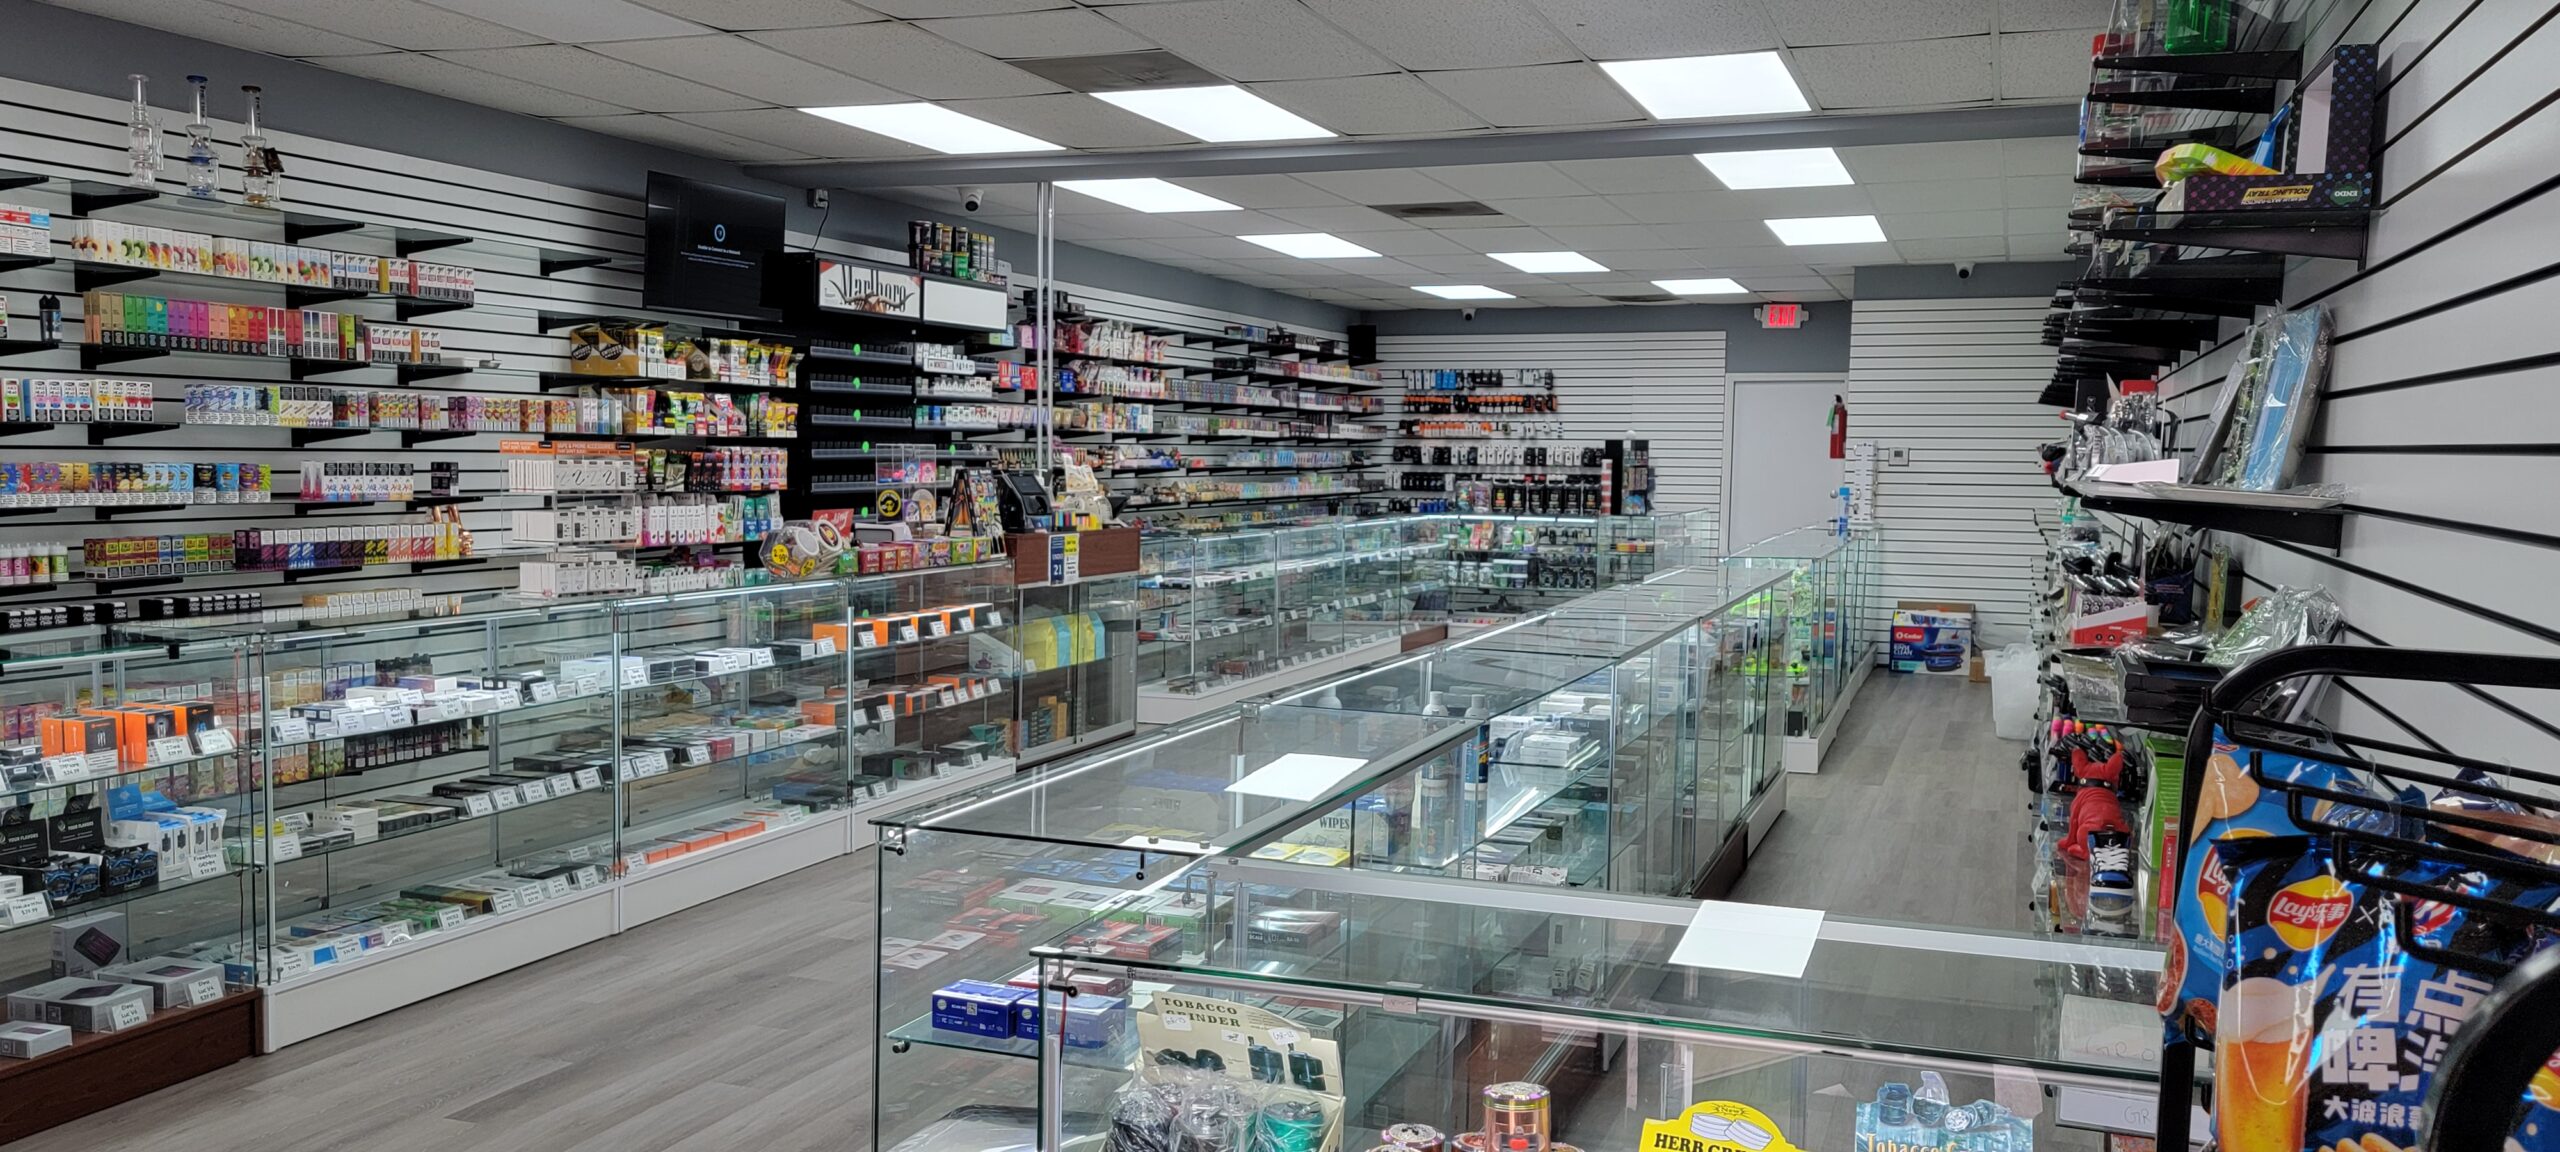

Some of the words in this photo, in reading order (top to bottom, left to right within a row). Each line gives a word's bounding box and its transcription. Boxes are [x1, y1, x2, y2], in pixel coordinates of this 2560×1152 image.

[2247, 190, 2271, 198] TRAY
[2272, 188, 2309, 196] ROLLING
[840, 264, 907, 313] Marlboro
[1769, 304, 1797, 327] EXIT
[1320, 817, 1350, 830] WIPES
[1162, 997, 1237, 1015] TOBACCO
[2337, 964, 2493, 1036] 有点
[1721, 1107, 1741, 1115] New
[1654, 1133, 1704, 1152] HERB
